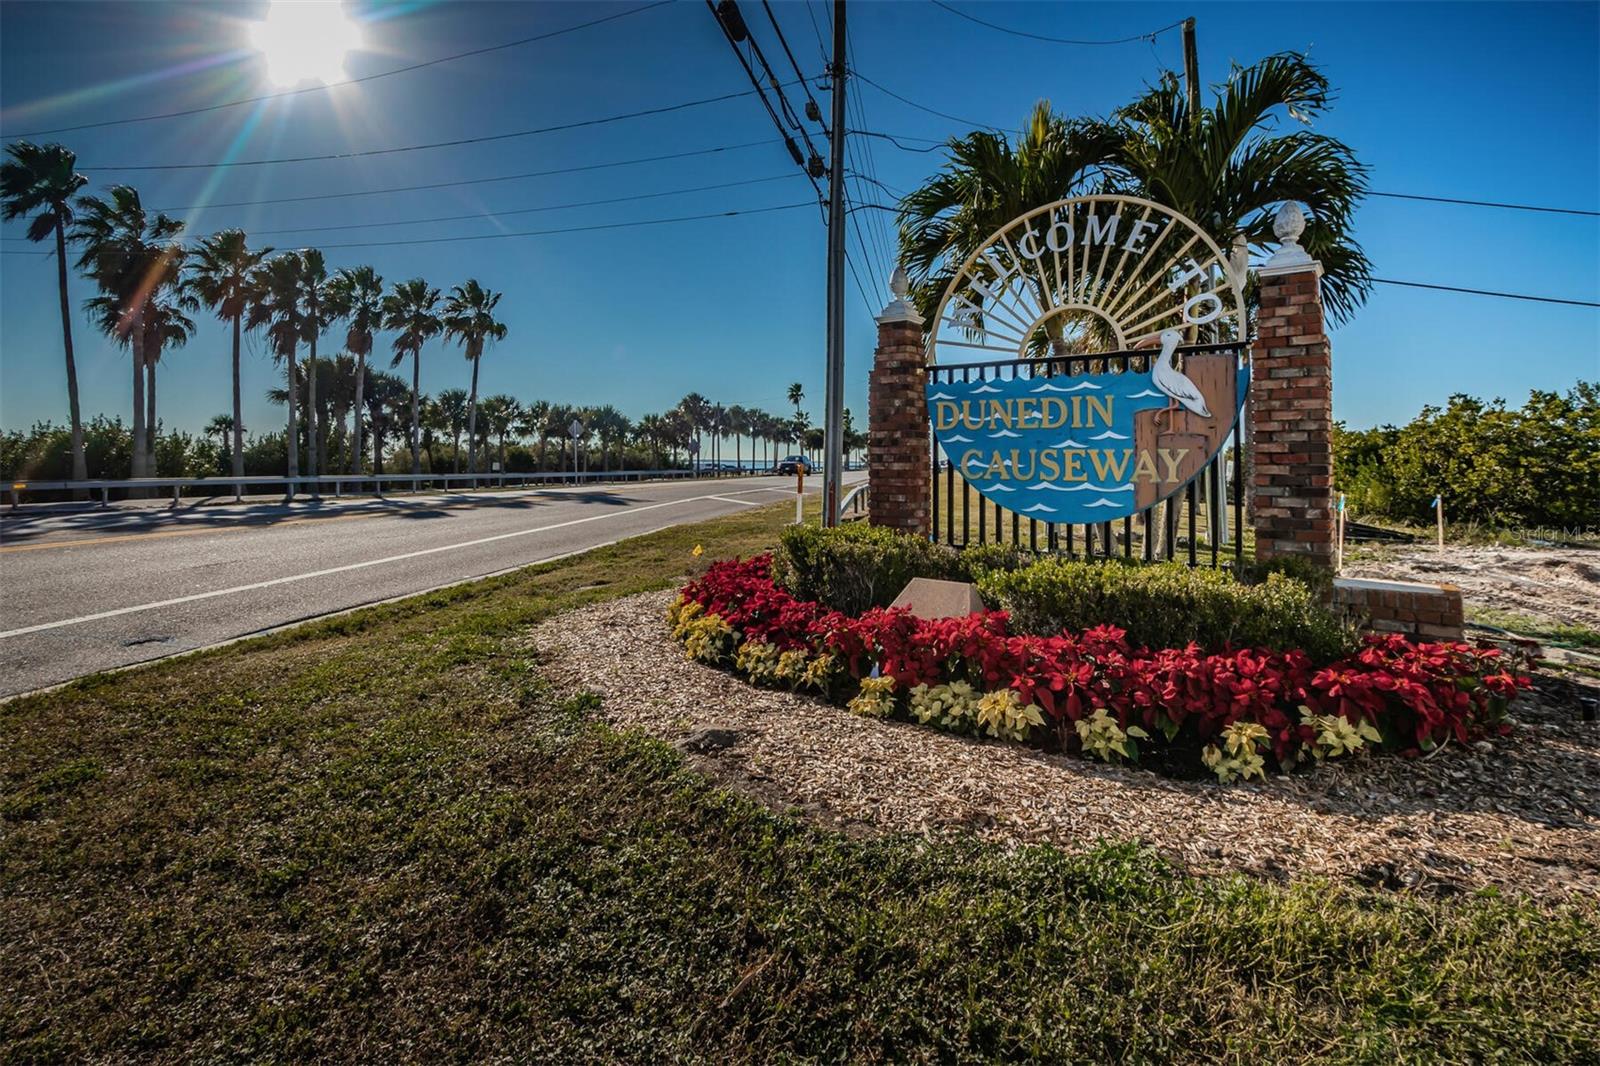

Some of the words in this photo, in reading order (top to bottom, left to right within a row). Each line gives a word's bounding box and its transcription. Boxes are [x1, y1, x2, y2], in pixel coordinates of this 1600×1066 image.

[946, 213, 1159, 329] WELCOME
[1168, 257, 1222, 325] TO
[935, 394, 1115, 431] DUNEDIN
[960, 448, 1190, 483] CAUSEWAY
